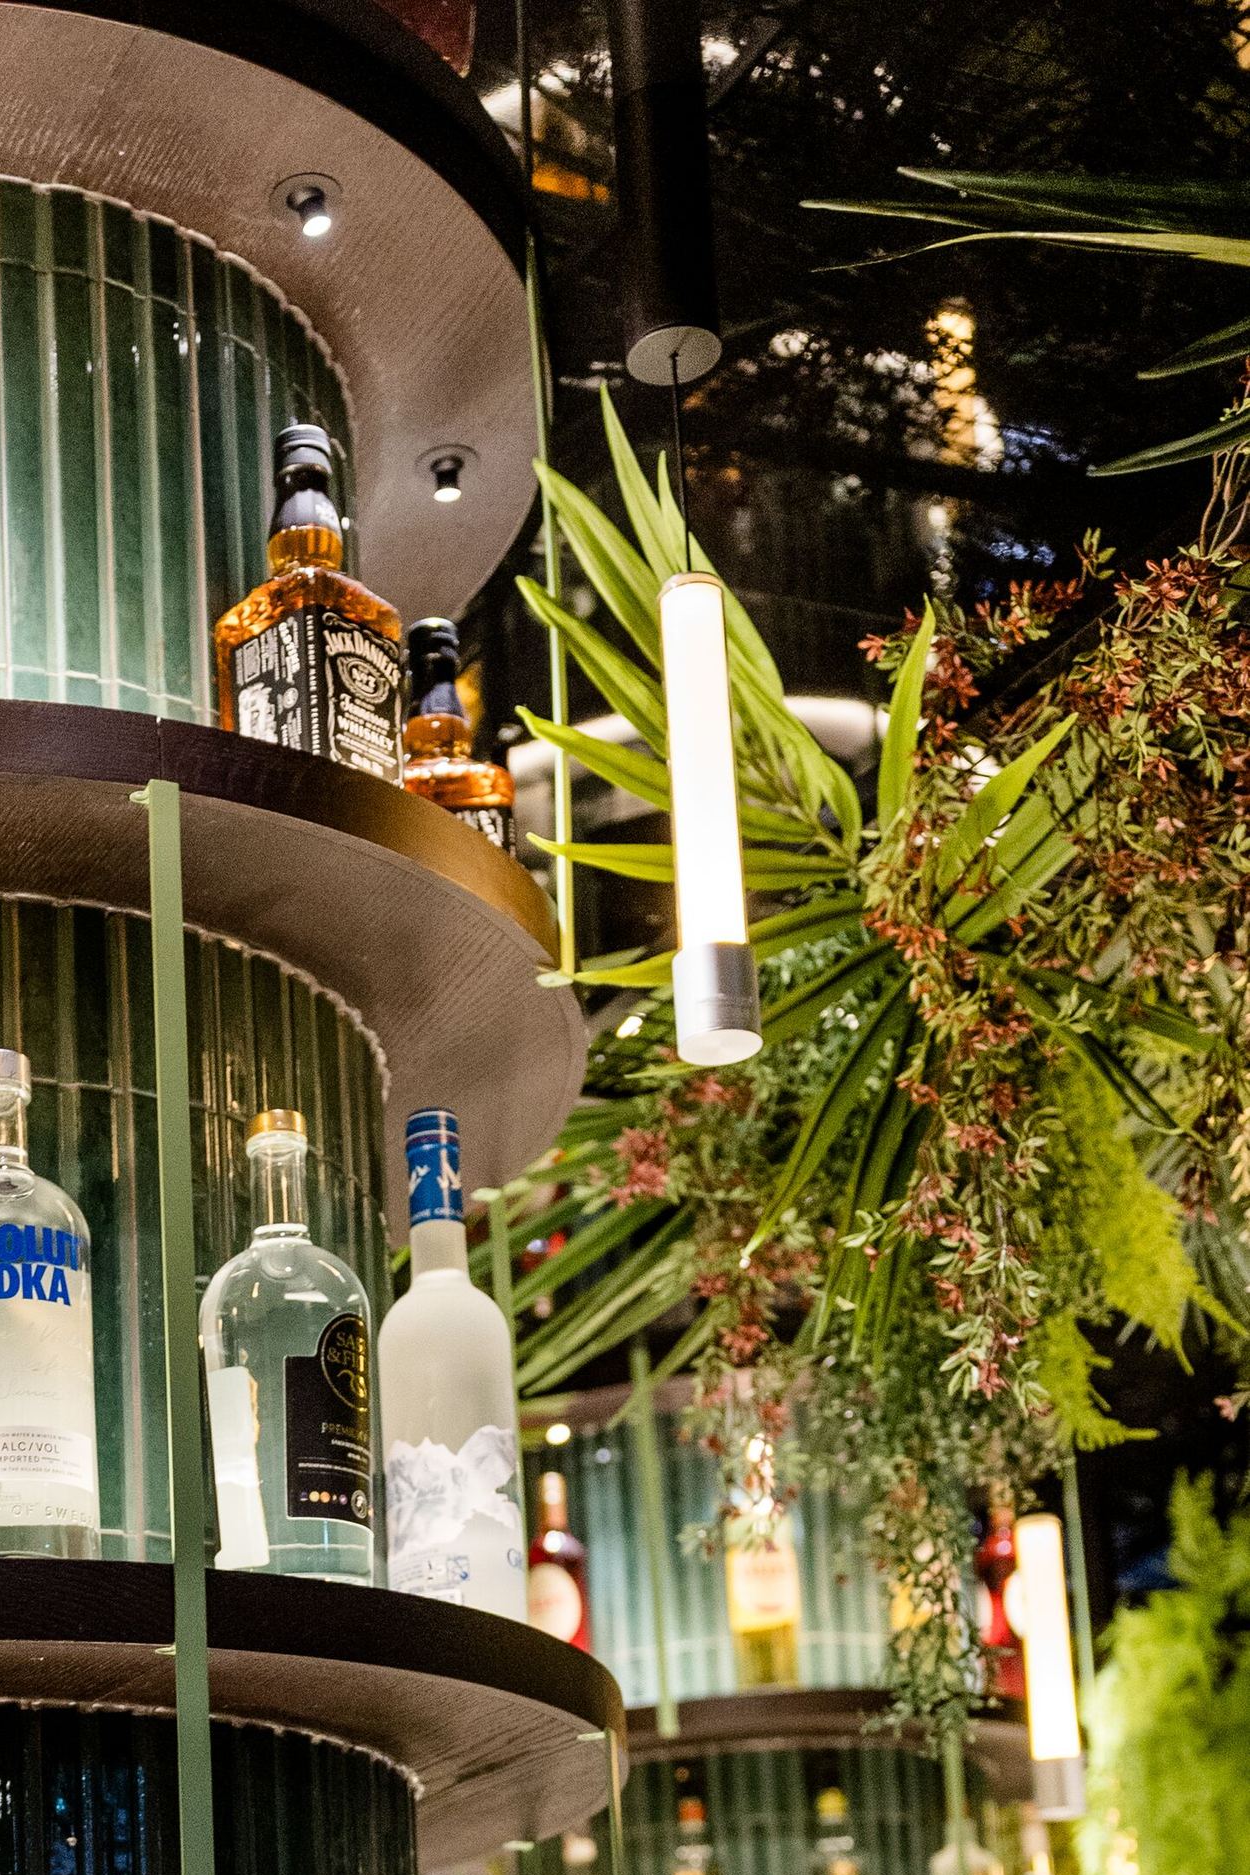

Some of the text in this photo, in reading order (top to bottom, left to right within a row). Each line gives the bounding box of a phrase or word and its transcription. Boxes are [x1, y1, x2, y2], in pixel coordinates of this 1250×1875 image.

[323, 630, 354, 656] JACK
[352, 631, 401, 688] DANIEL'S
[337, 715, 395, 751] WHISKEY
[1, 1441, 61, 1454] ALC/VOL
